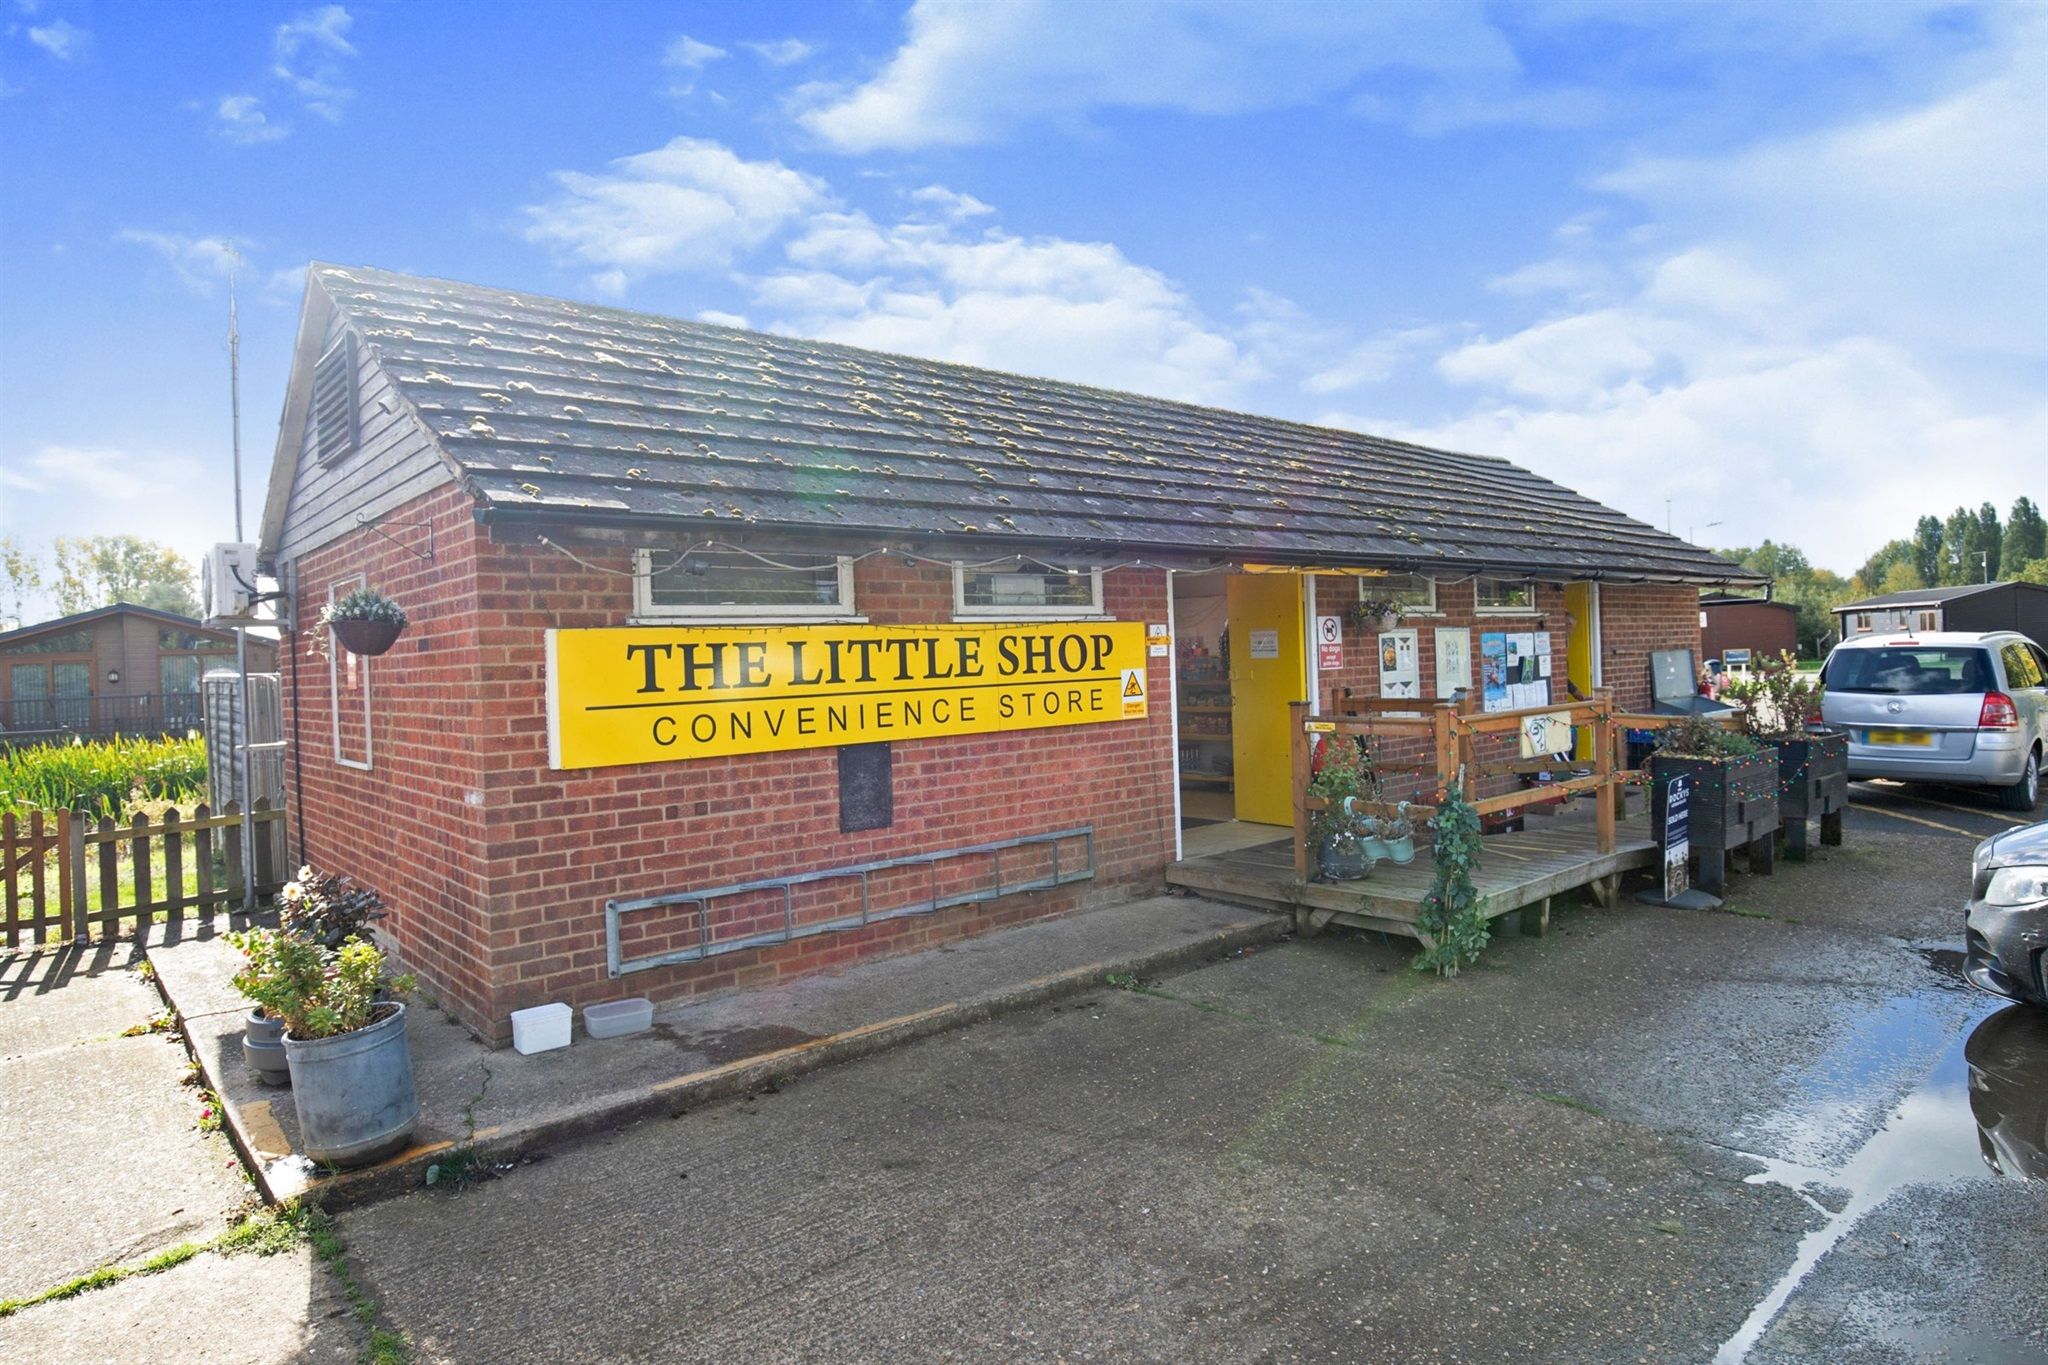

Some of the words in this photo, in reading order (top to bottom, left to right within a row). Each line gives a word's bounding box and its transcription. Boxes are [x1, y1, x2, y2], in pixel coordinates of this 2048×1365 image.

[627, 640, 773, 694] THE
[787, 637, 985, 686] LITTLE
[998, 634, 1114, 676] SHOP
[652, 698, 976, 746] CONVENIENCE
[1000, 688, 1104, 718] STORE
